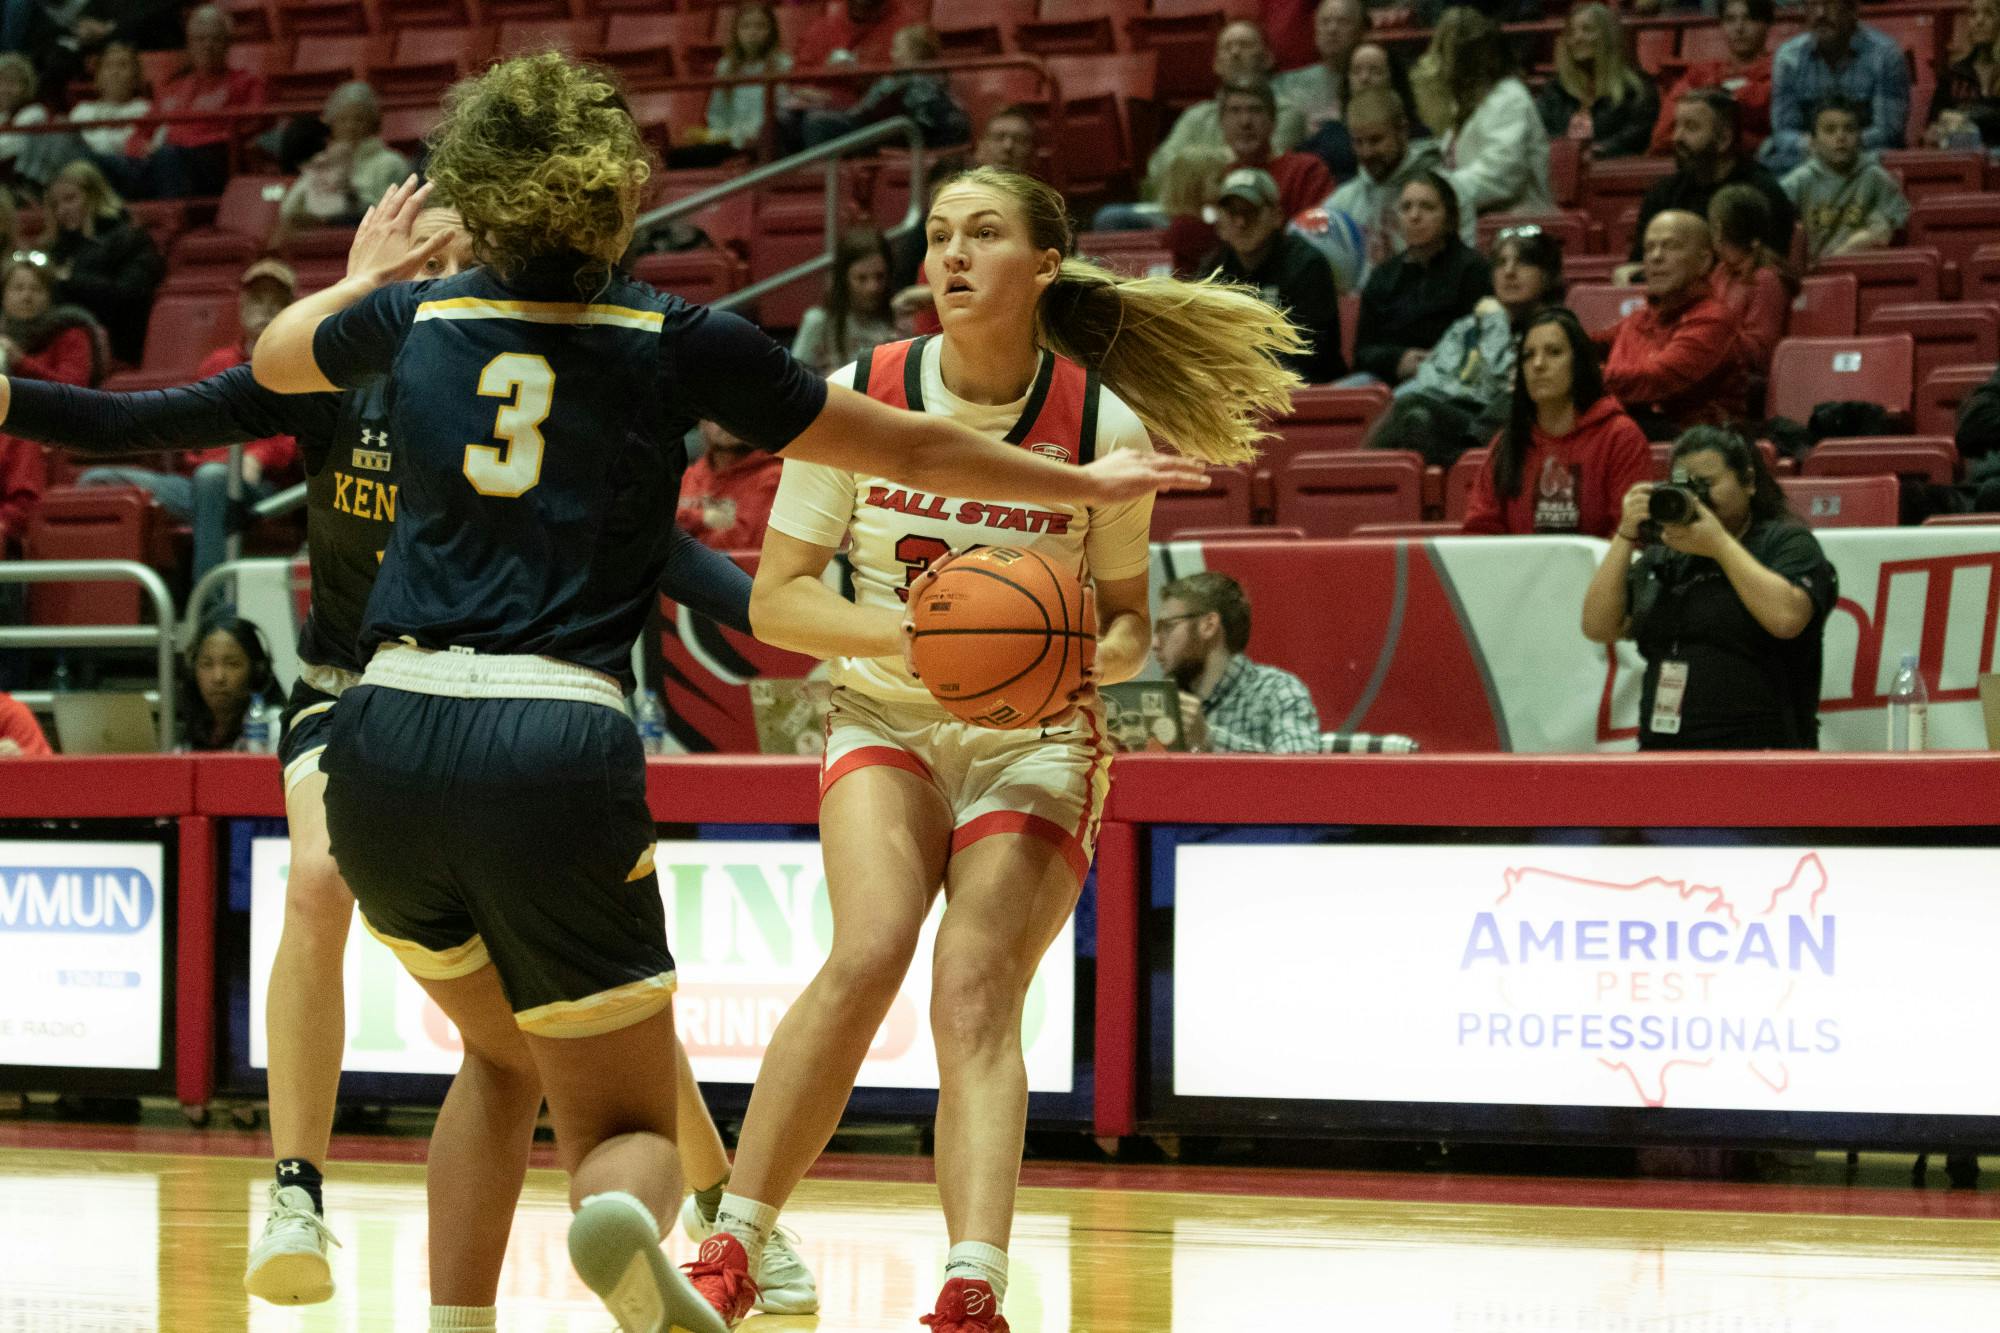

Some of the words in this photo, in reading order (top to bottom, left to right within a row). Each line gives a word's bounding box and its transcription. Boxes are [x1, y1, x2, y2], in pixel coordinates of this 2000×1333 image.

[463, 352, 557, 498] 3
[865, 486, 950, 521] BALL
[956, 501, 1073, 535] STATE
[1460, 911, 1836, 977] AMERICAN
[1596, 971, 1717, 1003] PEST
[22, 1018, 87, 1039] RADIO
[1457, 1011, 1842, 1055] PROFESSIONALS
